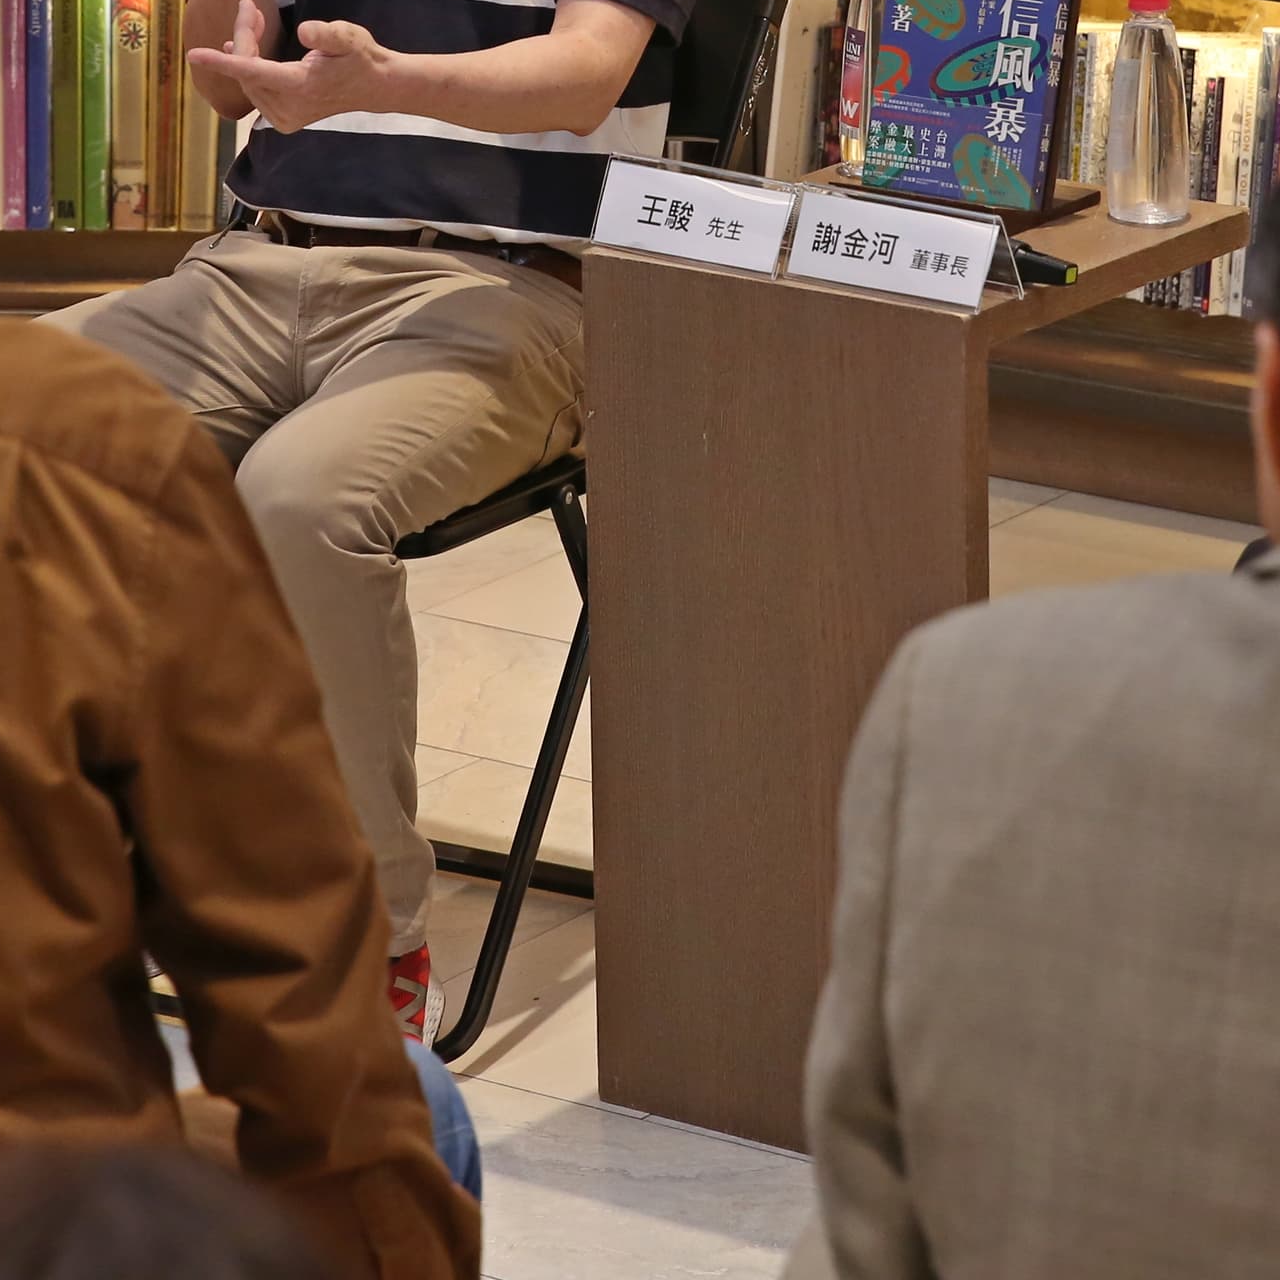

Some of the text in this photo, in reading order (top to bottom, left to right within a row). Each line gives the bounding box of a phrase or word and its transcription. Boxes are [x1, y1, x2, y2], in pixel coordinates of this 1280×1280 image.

[891, 3, 914, 33] 著
[845, 41, 861, 57] UNI
[841, 97, 860, 119] W
[1238, 104, 1254, 198] LAWSON YOU
[637, 194, 744, 242] 王駿 先生
[811, 221, 970, 280] 謝金河 董事長
